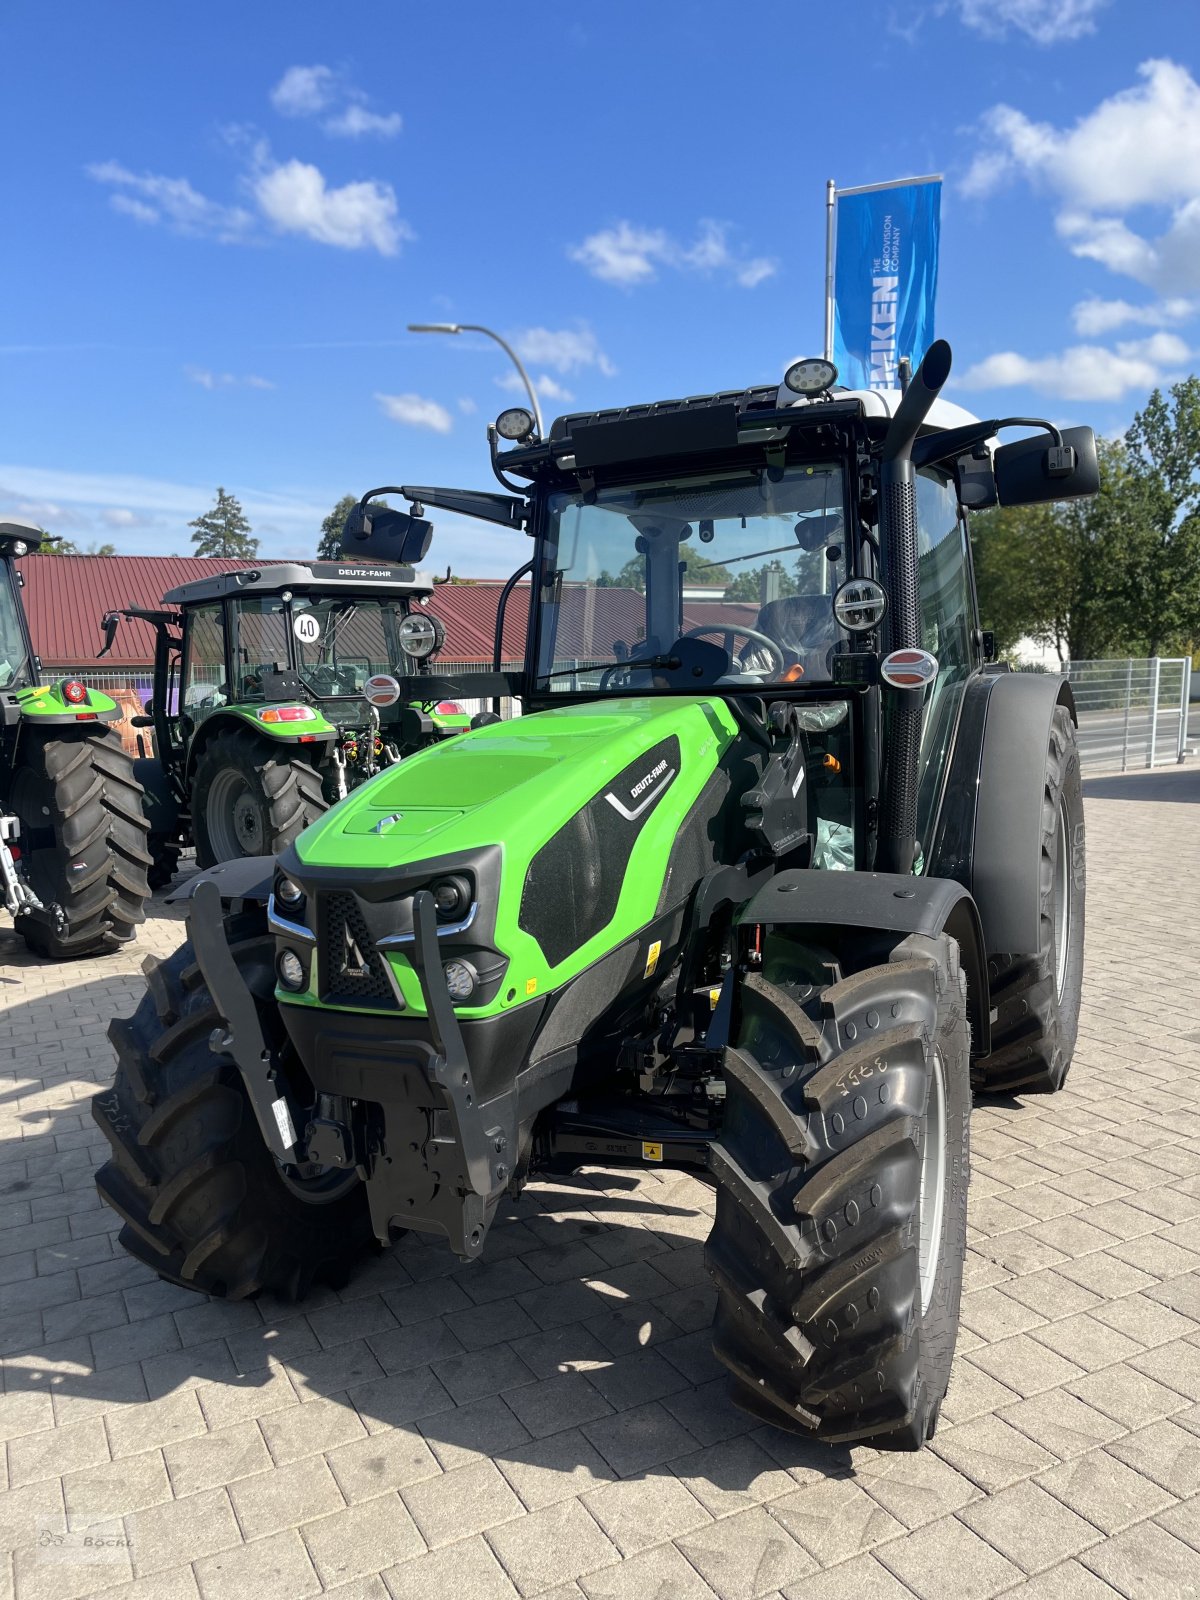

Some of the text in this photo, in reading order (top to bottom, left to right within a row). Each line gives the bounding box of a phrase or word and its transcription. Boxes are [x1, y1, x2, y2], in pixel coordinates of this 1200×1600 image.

[882, 215, 892, 273] AGROVISION
[891, 227, 900, 272] COMPANY
[873, 257, 881, 273] THE
[338, 568, 392, 577] DEUTZ-FAHR
[300, 620, 315, 638] 40
[630, 759, 669, 799] DEUTZ-FAHR
